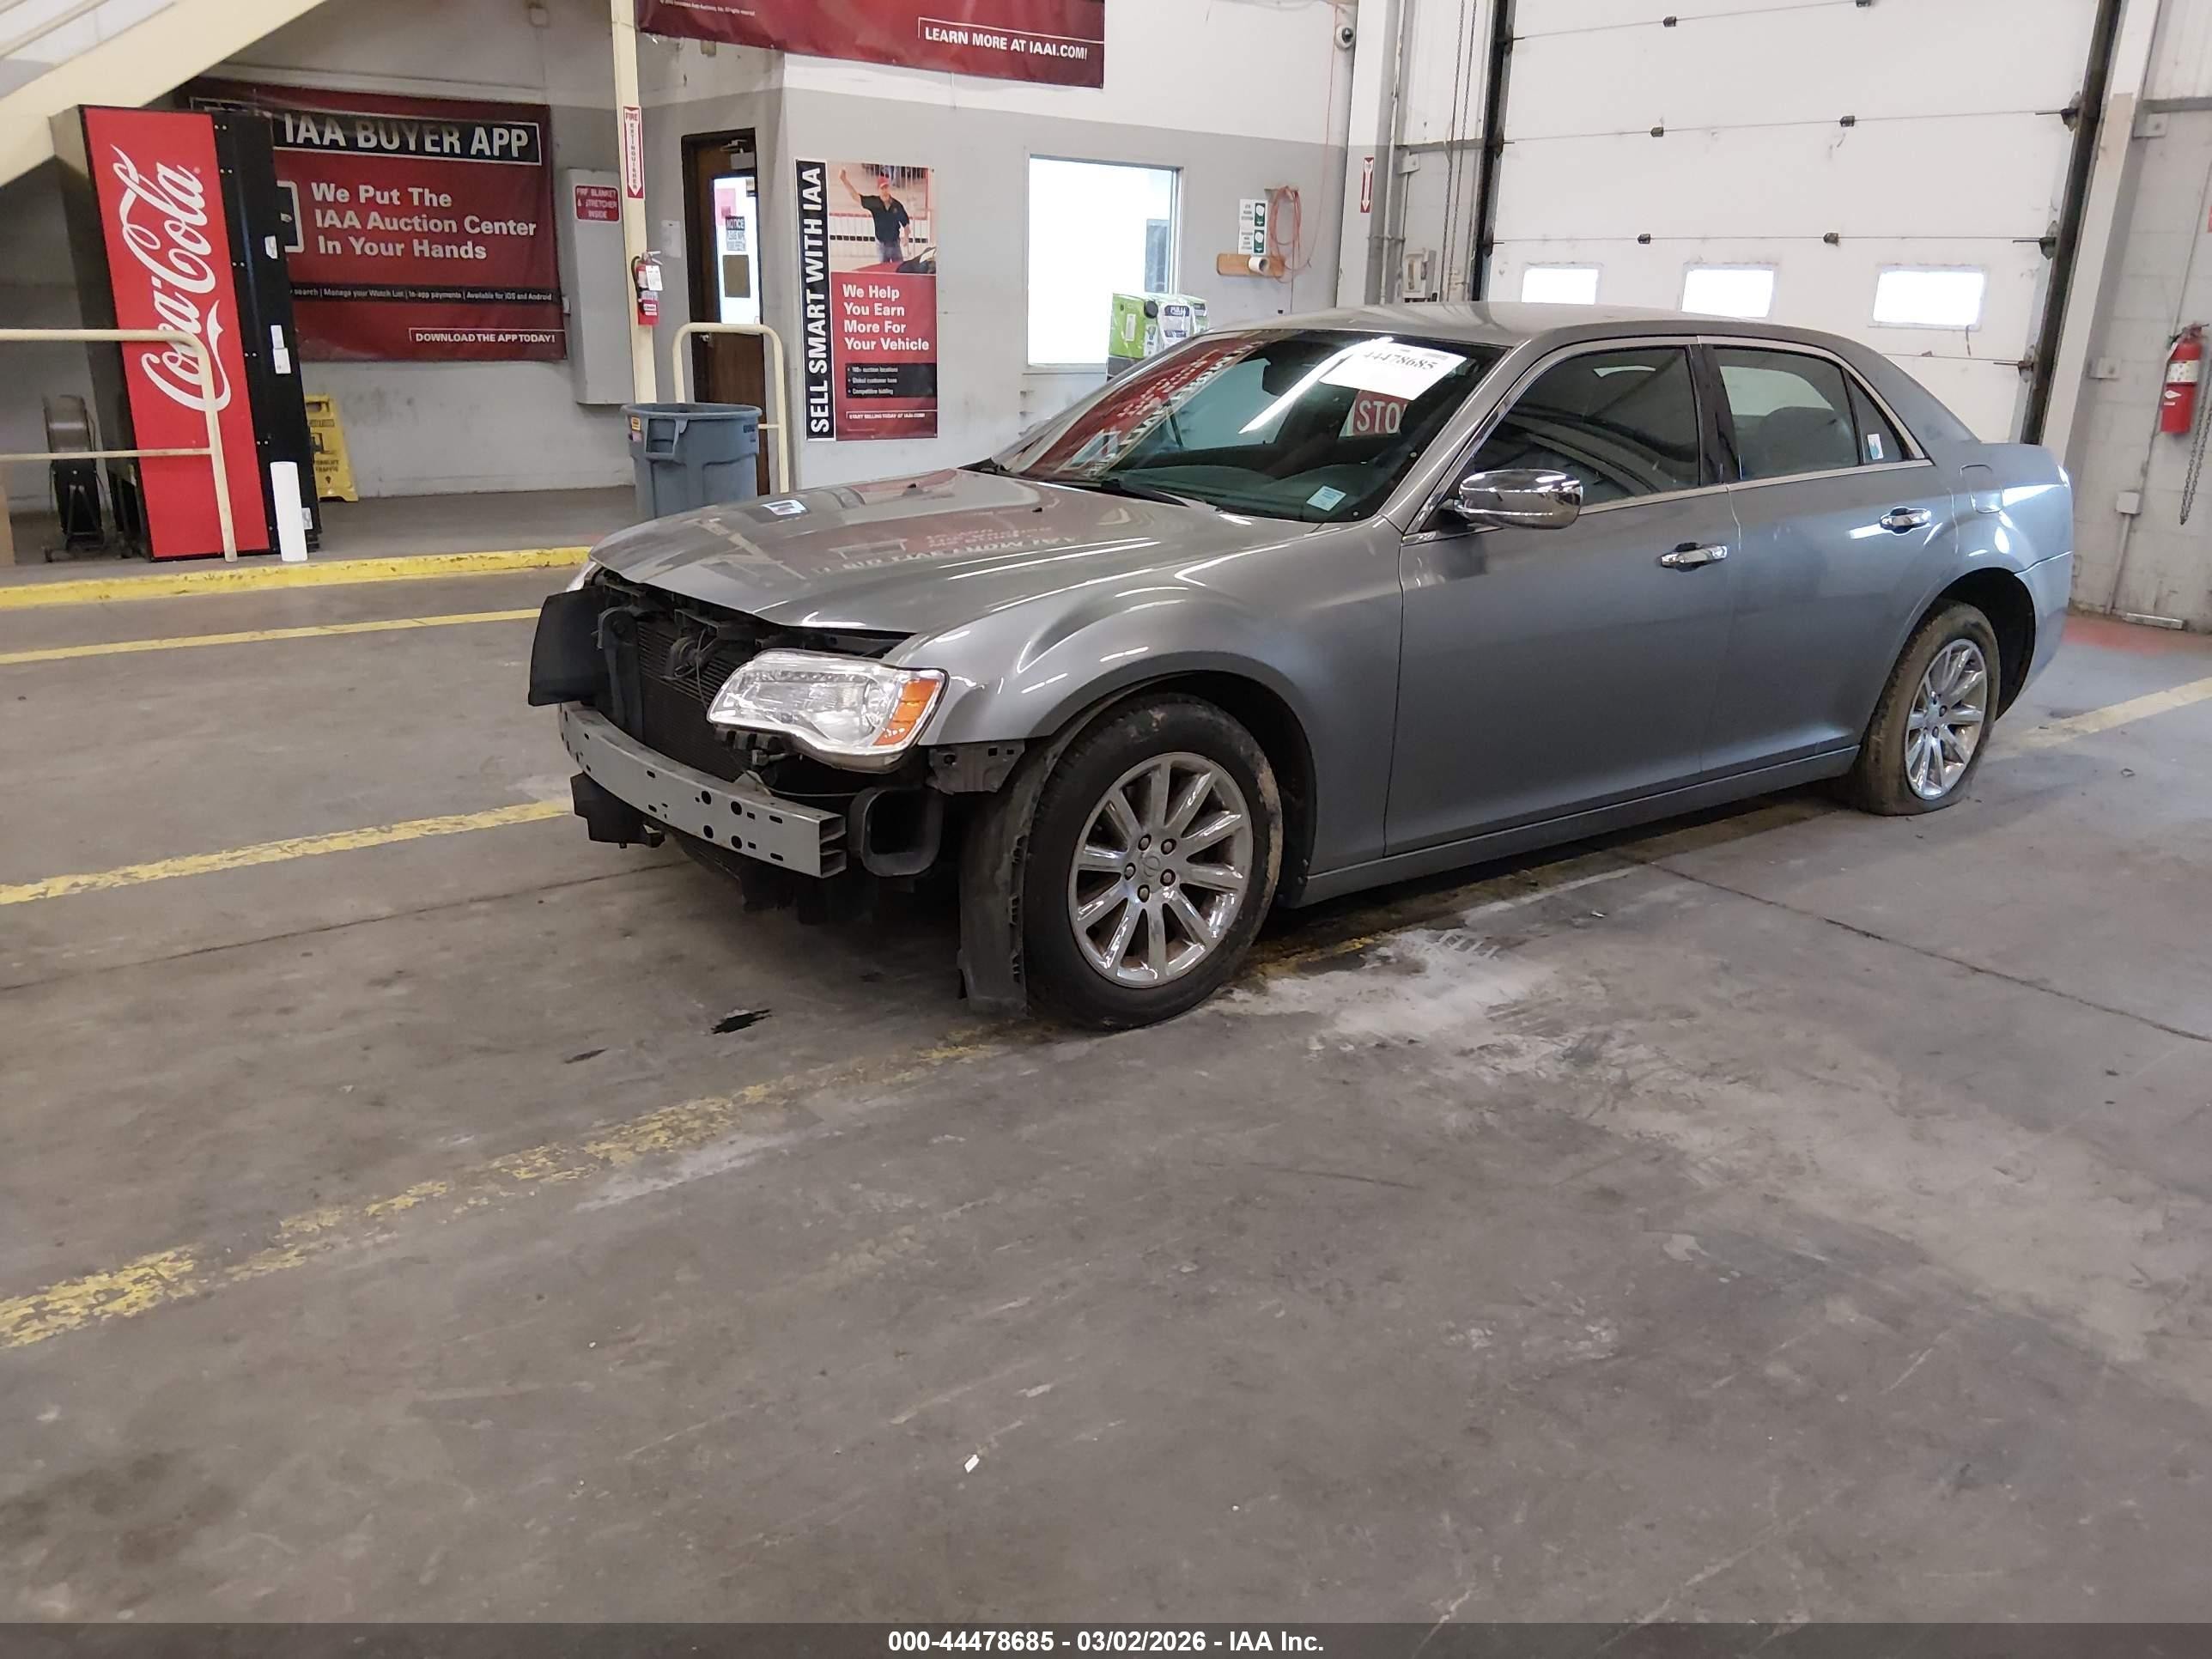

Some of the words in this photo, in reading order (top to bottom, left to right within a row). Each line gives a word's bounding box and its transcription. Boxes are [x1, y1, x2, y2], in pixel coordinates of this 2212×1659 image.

[925, 27, 969, 45] LEARN
[972, 33, 1008, 50] MORE
[1010, 39, 1027, 52] AT
[1030, 41, 1087, 60] IAAI.COM!
[625, 112, 637, 121] FIRE
[283, 112, 347, 147] IAA
[355, 119, 461, 155] BUYER
[470, 126, 529, 158] APP
[311, 182, 349, 203] We
[359, 185, 400, 205] Put
[408, 187, 452, 208] The
[802, 168, 821, 211] IAA
[315, 210, 361, 229] IAA
[367, 211, 457, 234] Auction
[464, 216, 536, 236] Center
[318, 235, 342, 255] In
[348, 236, 404, 258] Your
[412, 239, 487, 259] Hands
[804, 219, 823, 283] WITH
[324, 289, 352, 297] Manage
[842, 283, 864, 298] We
[869, 285, 900, 302] Help
[843, 302, 869, 316] You
[874, 303, 905, 316] Earn
[416, 333, 475, 342] DOWNLOAD
[519, 334, 555, 343] TODAY!
[805, 289, 827, 374] SMART
[844, 319, 879, 333] More
[884, 320, 907, 333] For
[845, 337, 876, 350] Your
[880, 337, 930, 350] Vehicle
[811, 380, 830, 433] SELL
[1357, 400, 1407, 434] STO
